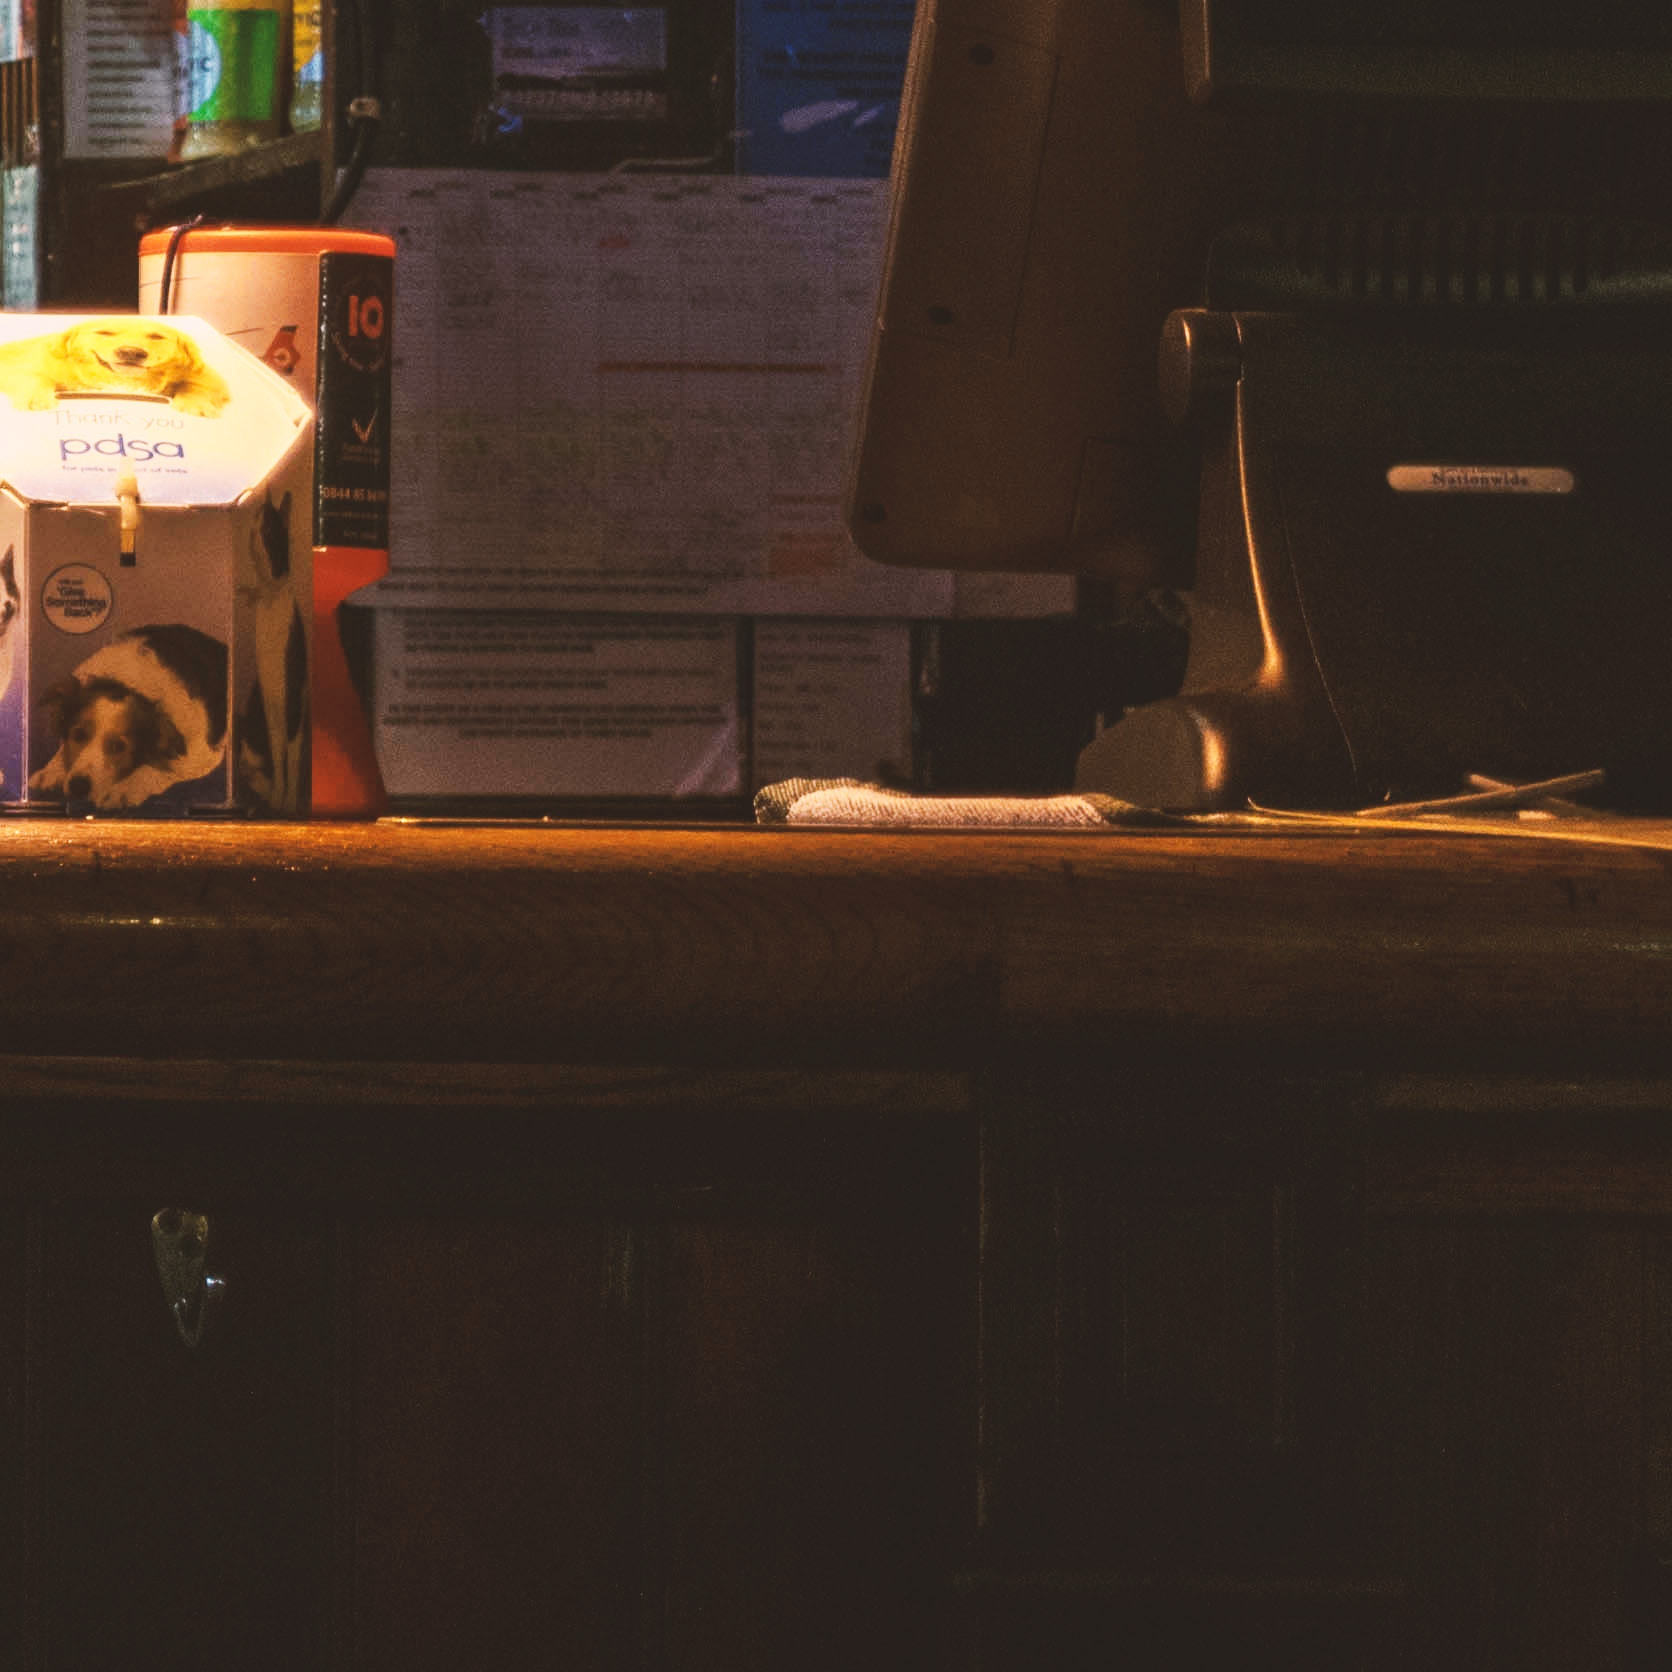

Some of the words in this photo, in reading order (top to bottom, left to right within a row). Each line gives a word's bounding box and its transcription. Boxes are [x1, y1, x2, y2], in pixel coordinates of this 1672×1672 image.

[50, 409, 131, 425] Thank
[142, 416, 185, 430] you
[59, 433, 185, 461] pdsa
[1431, 471, 1529, 487] Nationwide
